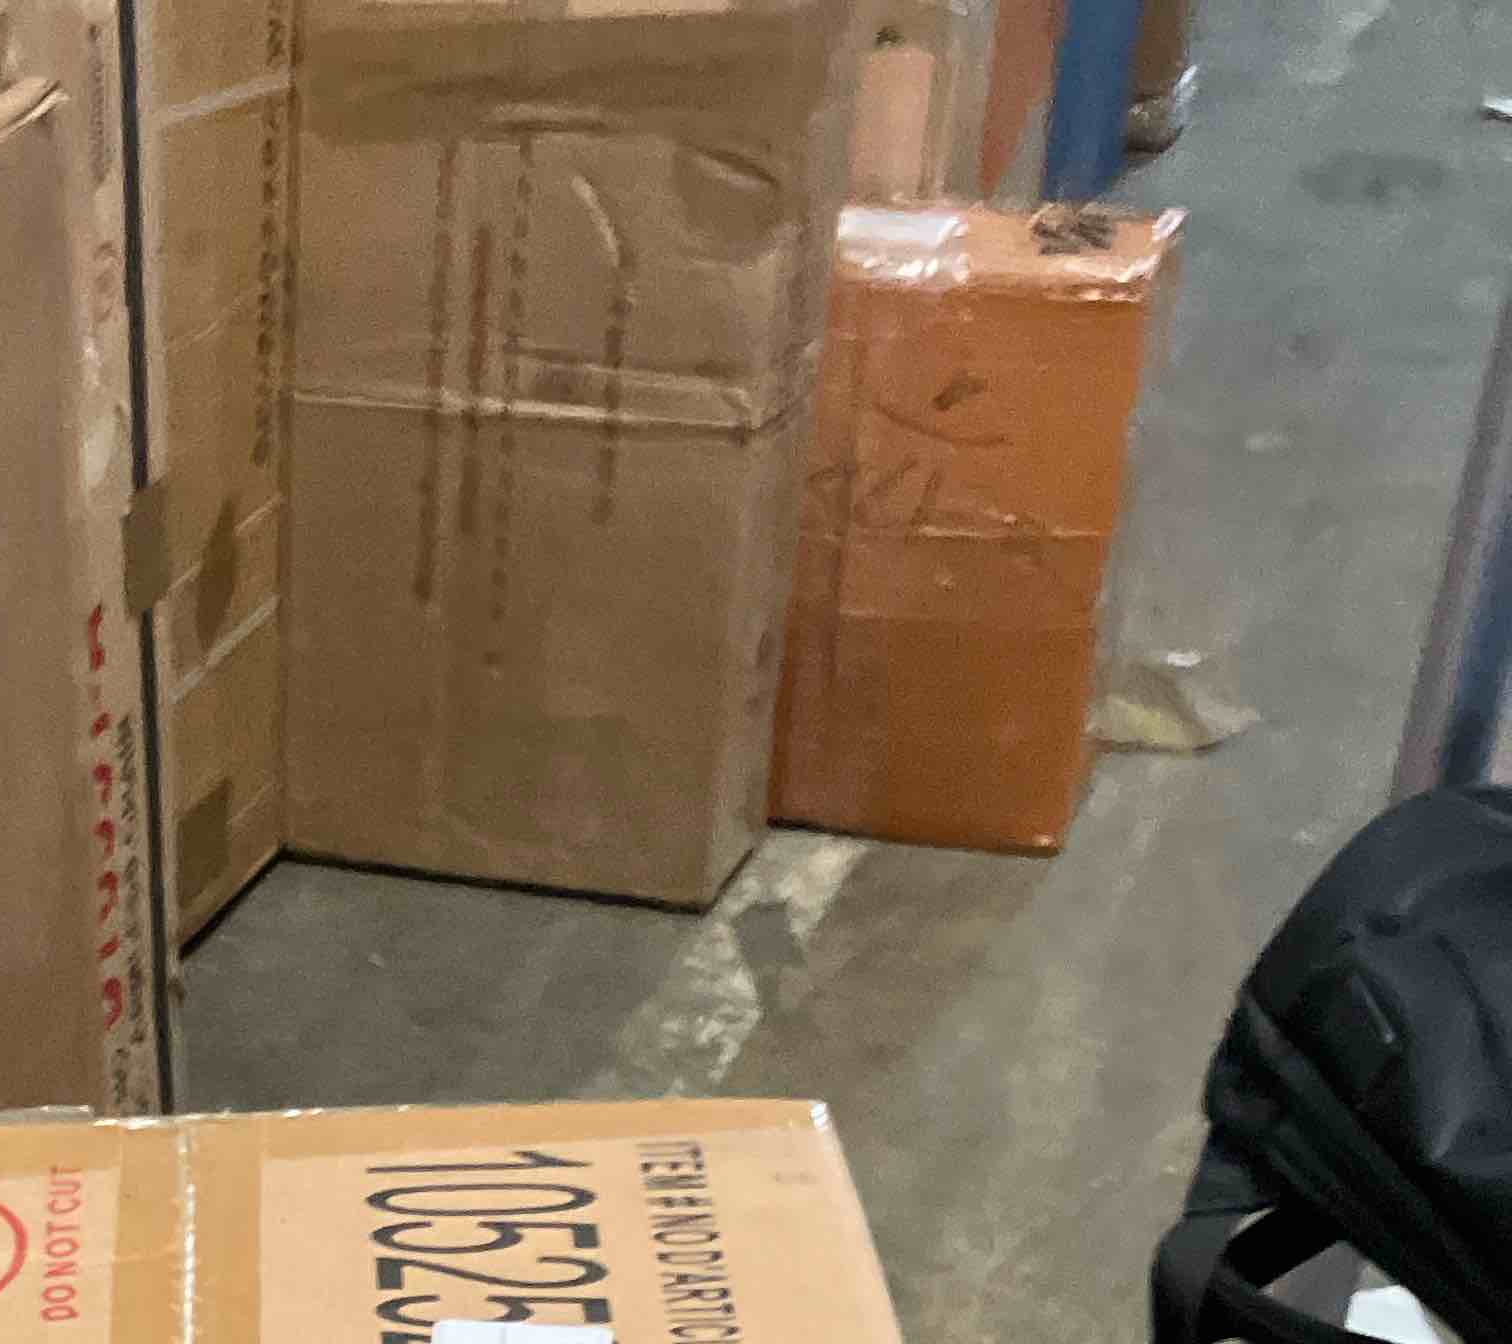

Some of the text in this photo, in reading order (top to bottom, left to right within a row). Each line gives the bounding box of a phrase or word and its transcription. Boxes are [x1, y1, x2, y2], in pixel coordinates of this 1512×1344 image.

[39, 1164, 84, 1323] DO NOT CUT
[648, 1211, 721, 1245] NO
